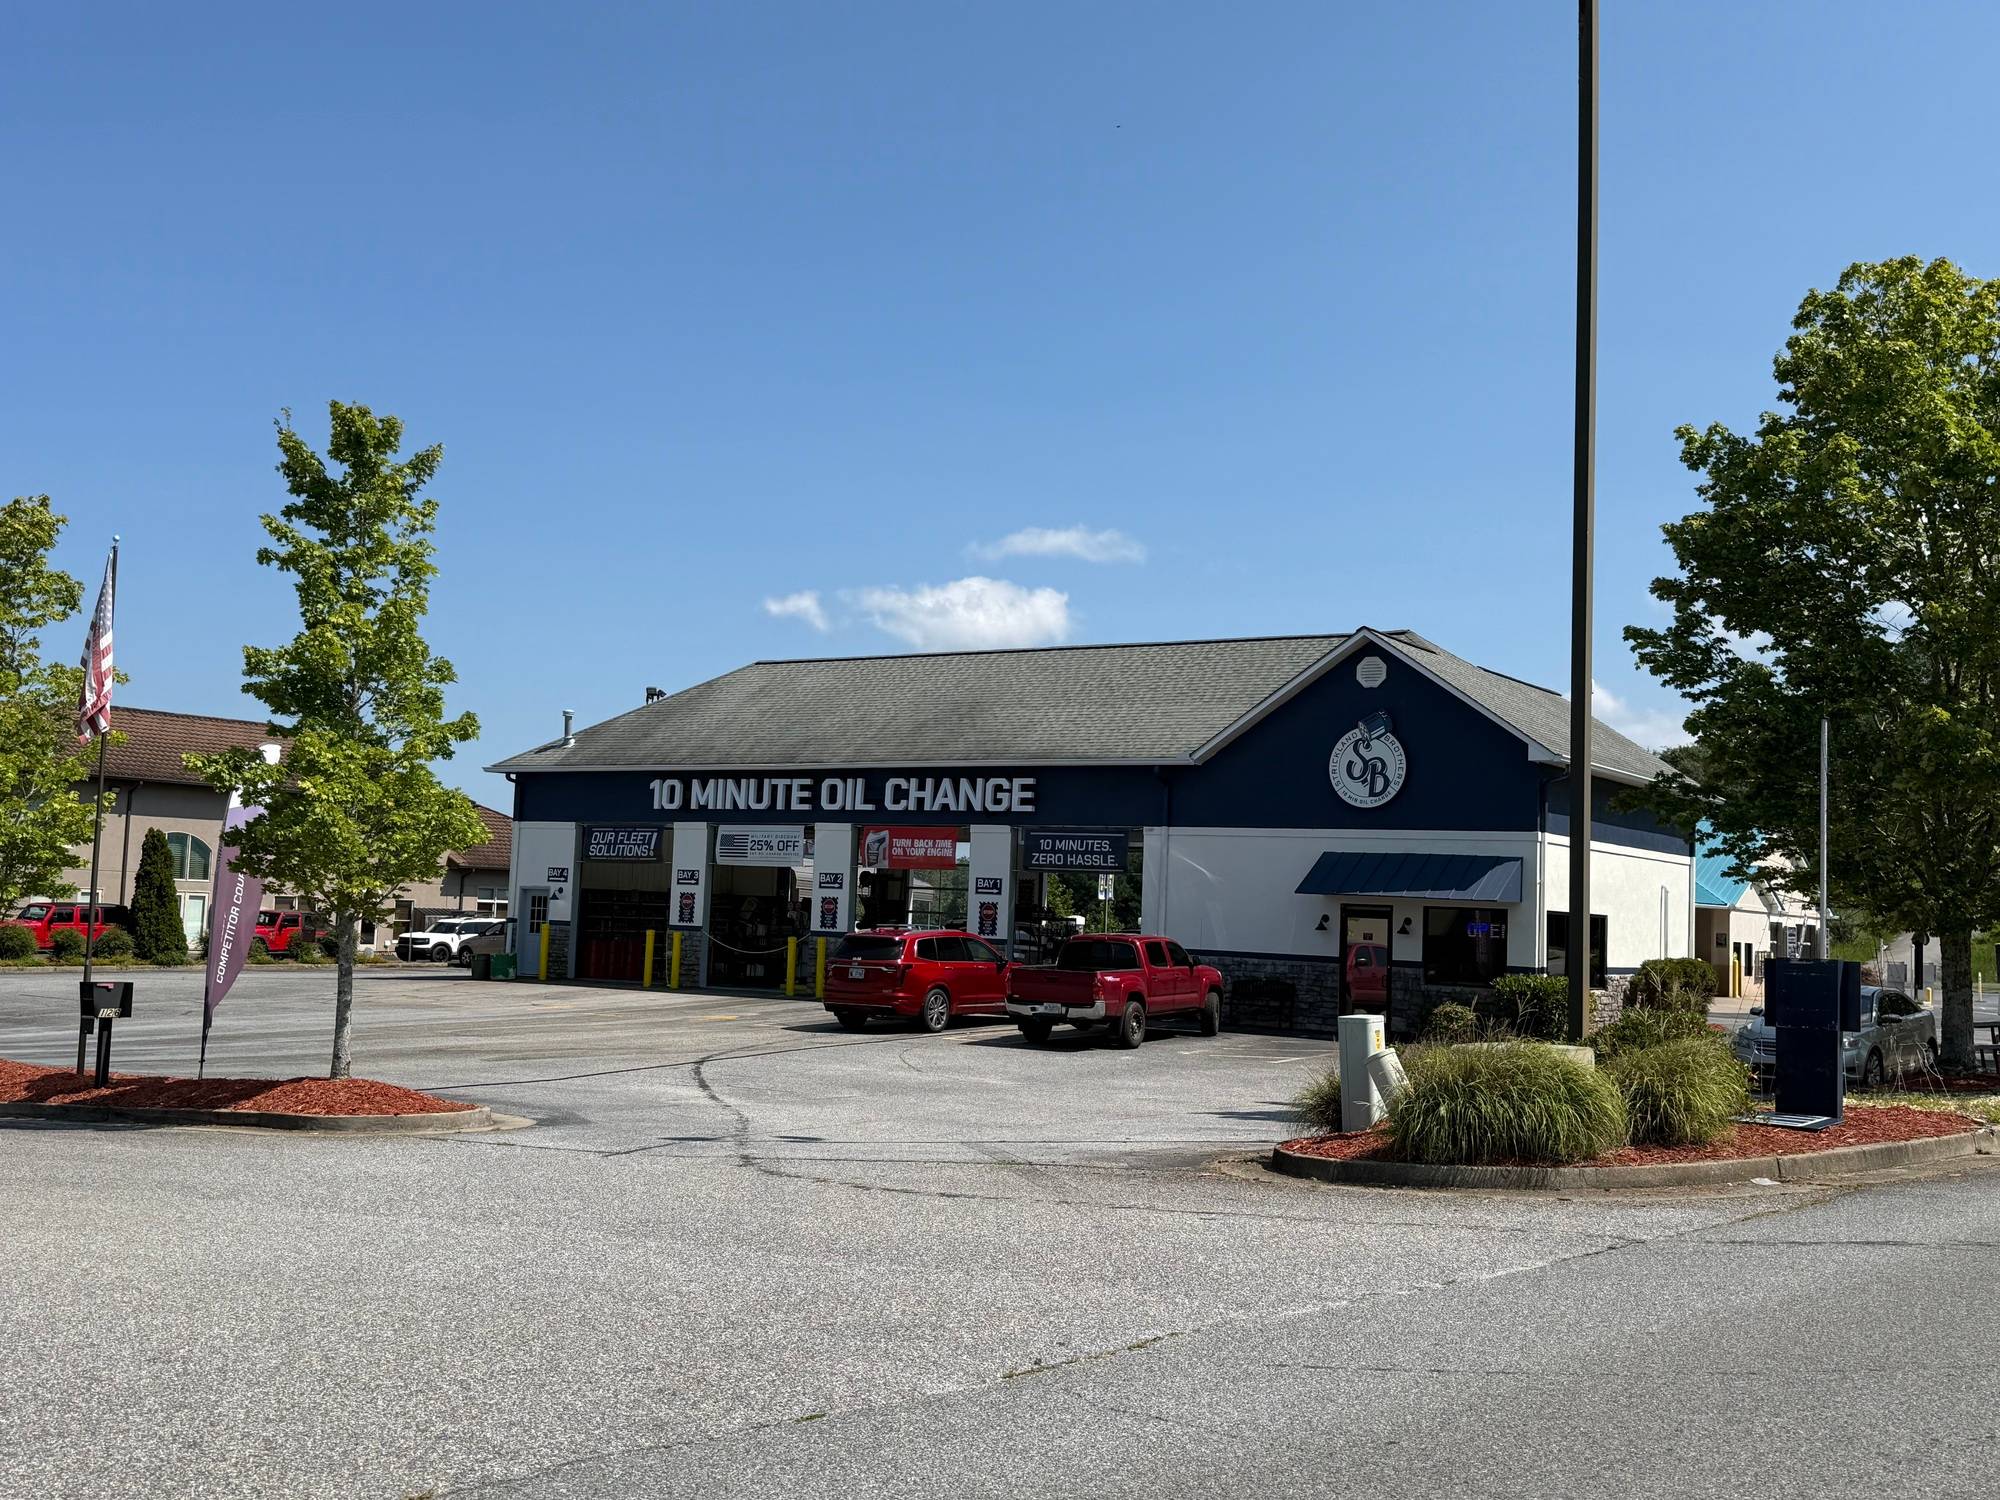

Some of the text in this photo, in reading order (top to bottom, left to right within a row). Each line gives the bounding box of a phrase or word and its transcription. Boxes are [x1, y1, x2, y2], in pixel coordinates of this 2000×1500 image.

[1331, 731, 1358, 787] STRICKLAND
[1383, 735, 1404, 787] BROTHERS
[650, 777, 1037, 813] 10 MINUTE OIL CHANGE
[1347, 795, 1359, 803] MIN
[1369, 790, 1392, 805] CHANGE
[591, 832, 652, 844] OUR FLEET
[892, 838, 953, 848] TURN BACK TIME
[749, 839, 800, 852] 25% OFF
[1040, 839, 1112, 852] 10 MINUTES.
[892, 847, 953, 857] ON YOUR ENGINE
[1031, 853, 1118, 866] ZERO HASSLE.
[548, 868, 568, 877] BAY 4
[678, 870, 699, 880] BAY 3
[820, 873, 843, 883] BAY 2
[977, 878, 1001, 888] BAY 1
[216, 906, 240, 984] COMPETITOR
[99, 1008, 121, 1018] 126
